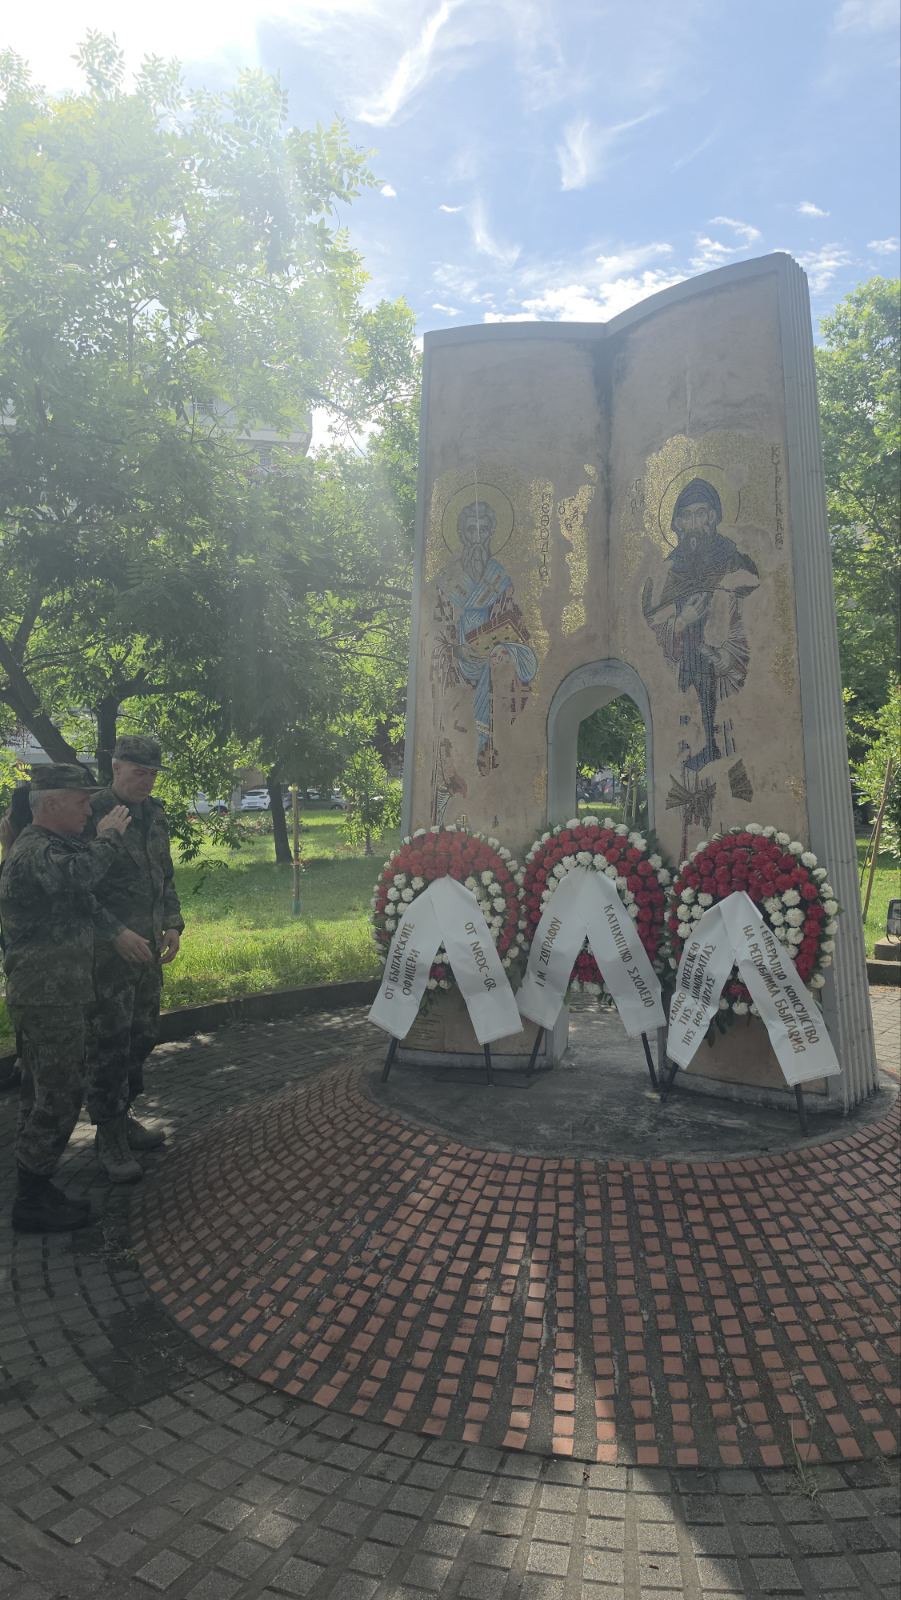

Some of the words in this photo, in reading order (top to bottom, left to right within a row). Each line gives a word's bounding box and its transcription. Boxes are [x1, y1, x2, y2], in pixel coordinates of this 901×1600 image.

[464, 922, 477, 936] ОТ
[742, 924, 755, 942] НА
[403, 949, 421, 996] ОФИЦЕРИ
[470, 941, 497, 991] NRDC-GR
[627, 966, 655, 1008] ΣΧΟΛΕΙΟ
[385, 986, 395, 999] ОТ
[783, 985, 820, 1044] КОНСУЛСТВО
